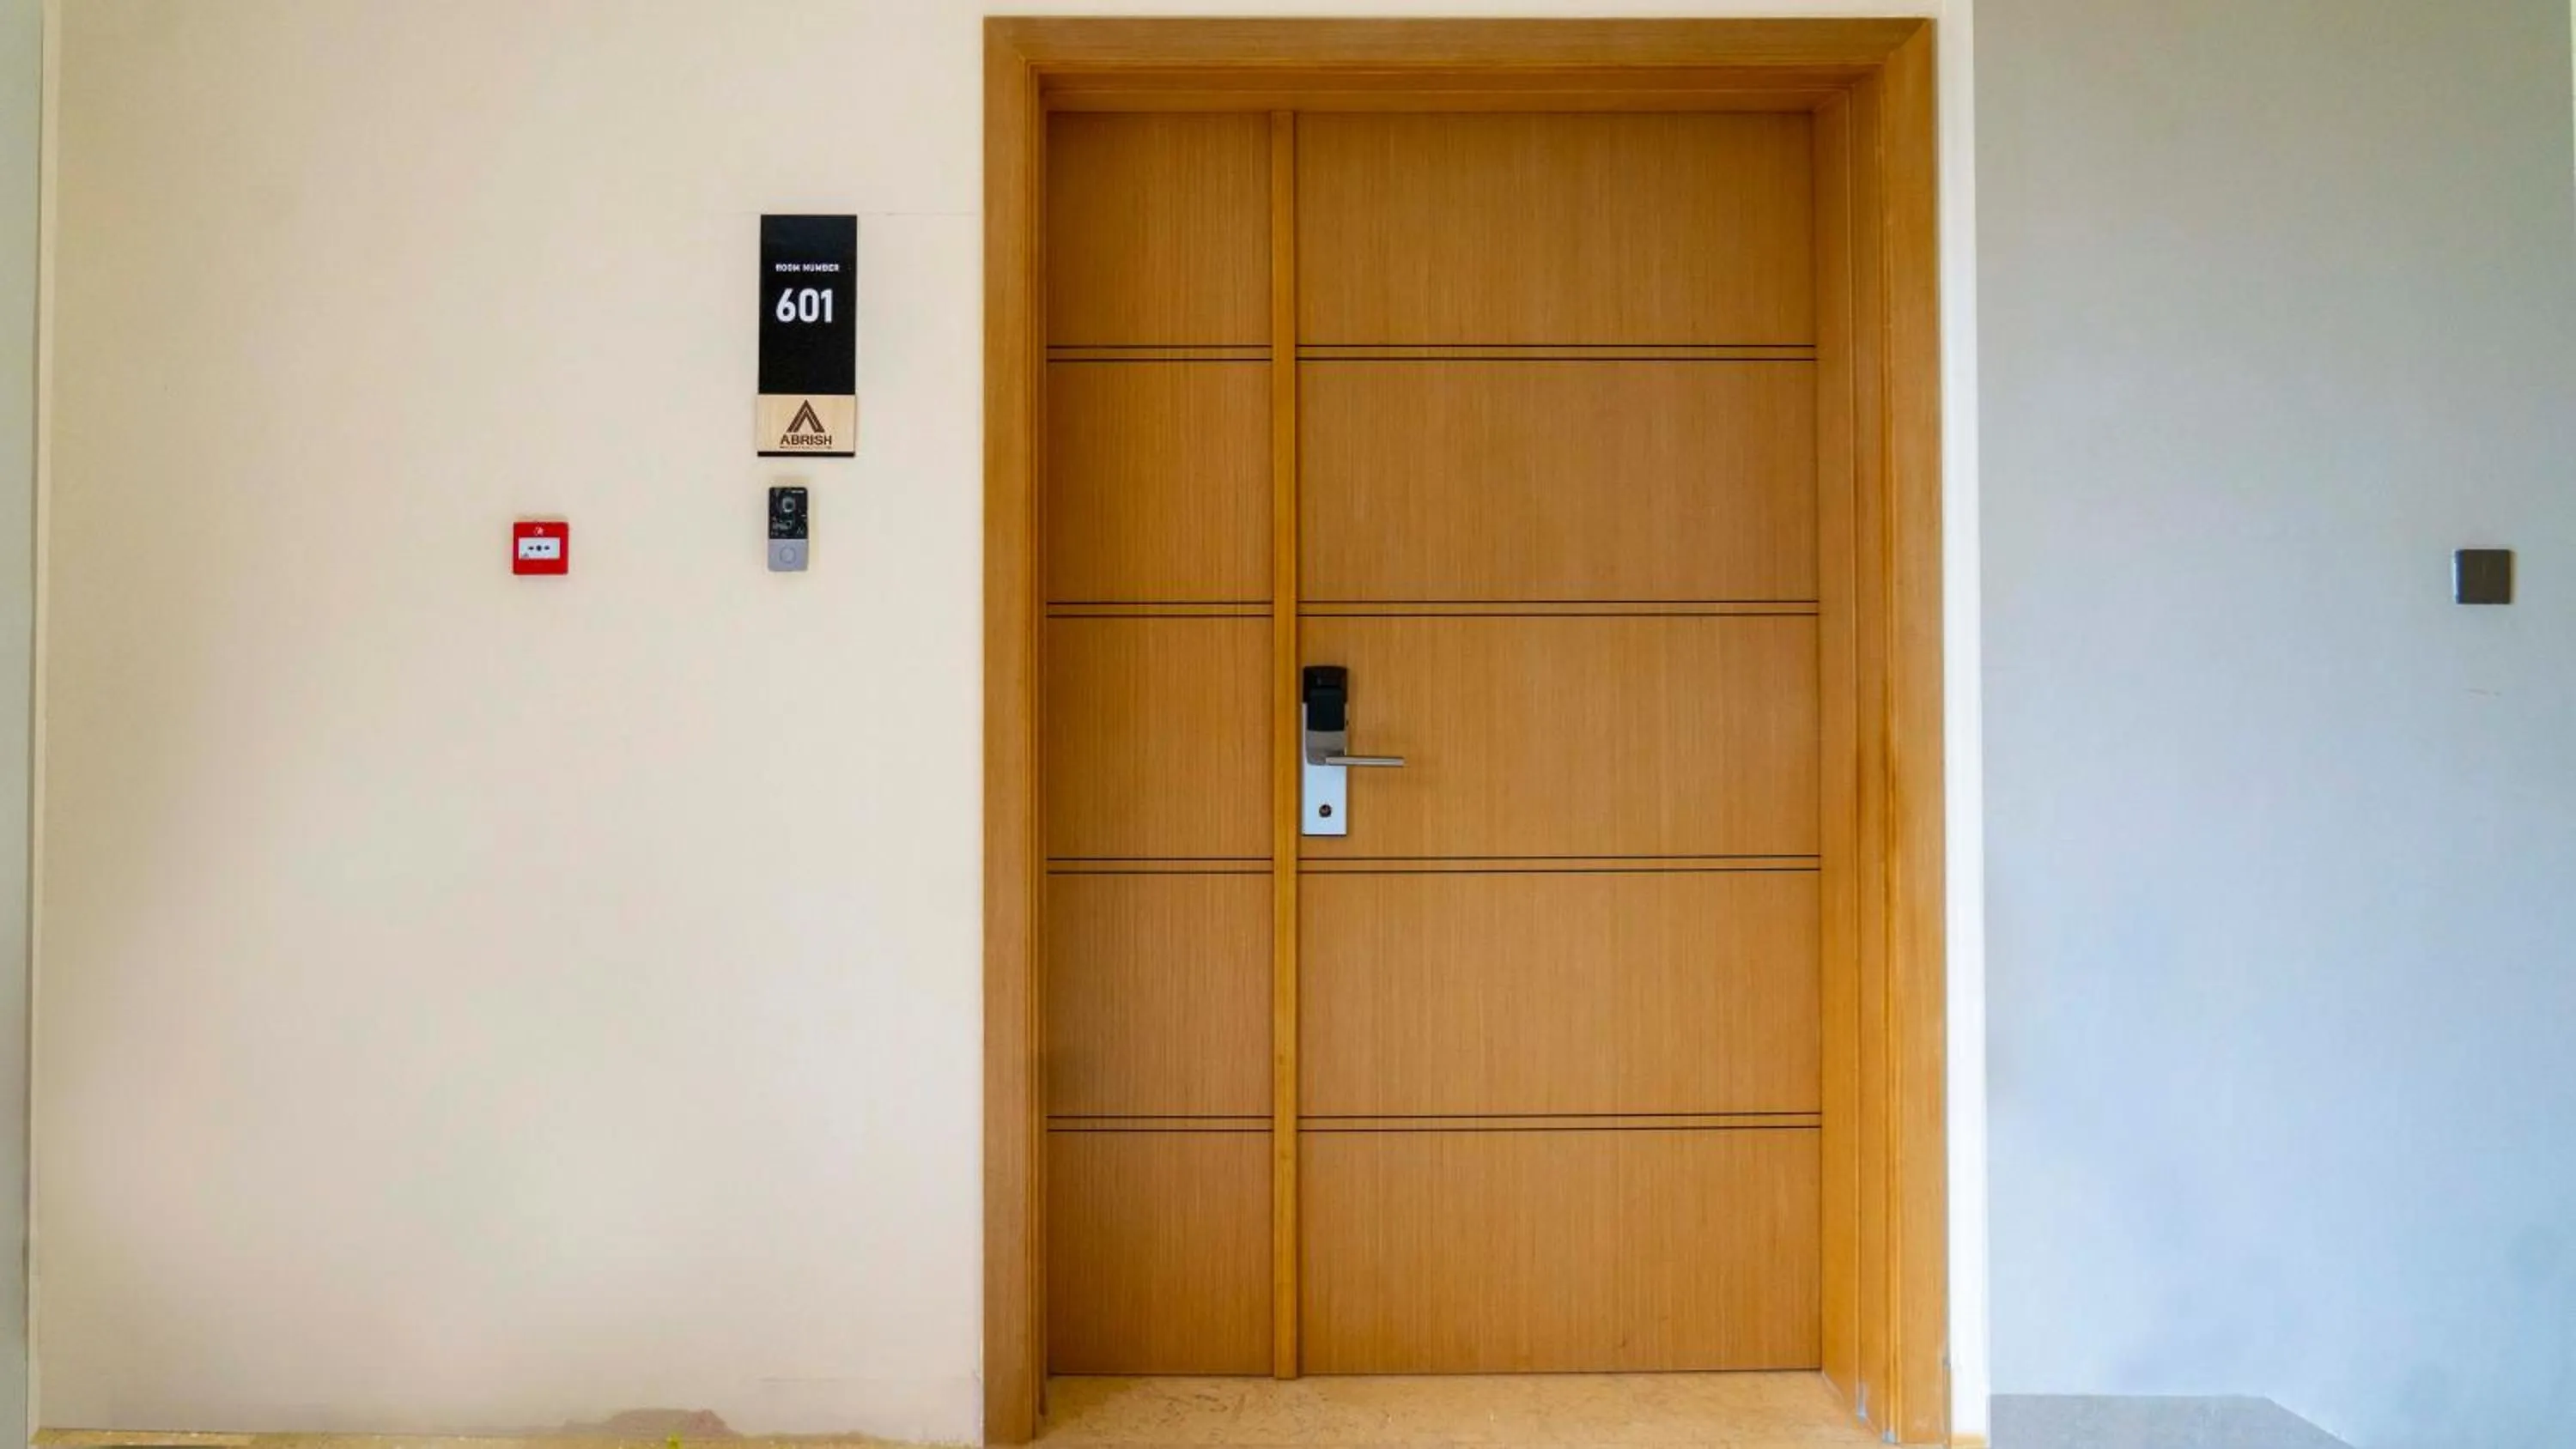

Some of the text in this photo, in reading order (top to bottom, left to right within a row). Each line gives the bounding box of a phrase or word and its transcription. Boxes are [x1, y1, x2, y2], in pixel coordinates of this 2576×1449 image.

[775, 264, 839, 272] ROOM NUMBER
[775, 288, 833, 323] 601
[780, 434, 832, 446] ABRISH
